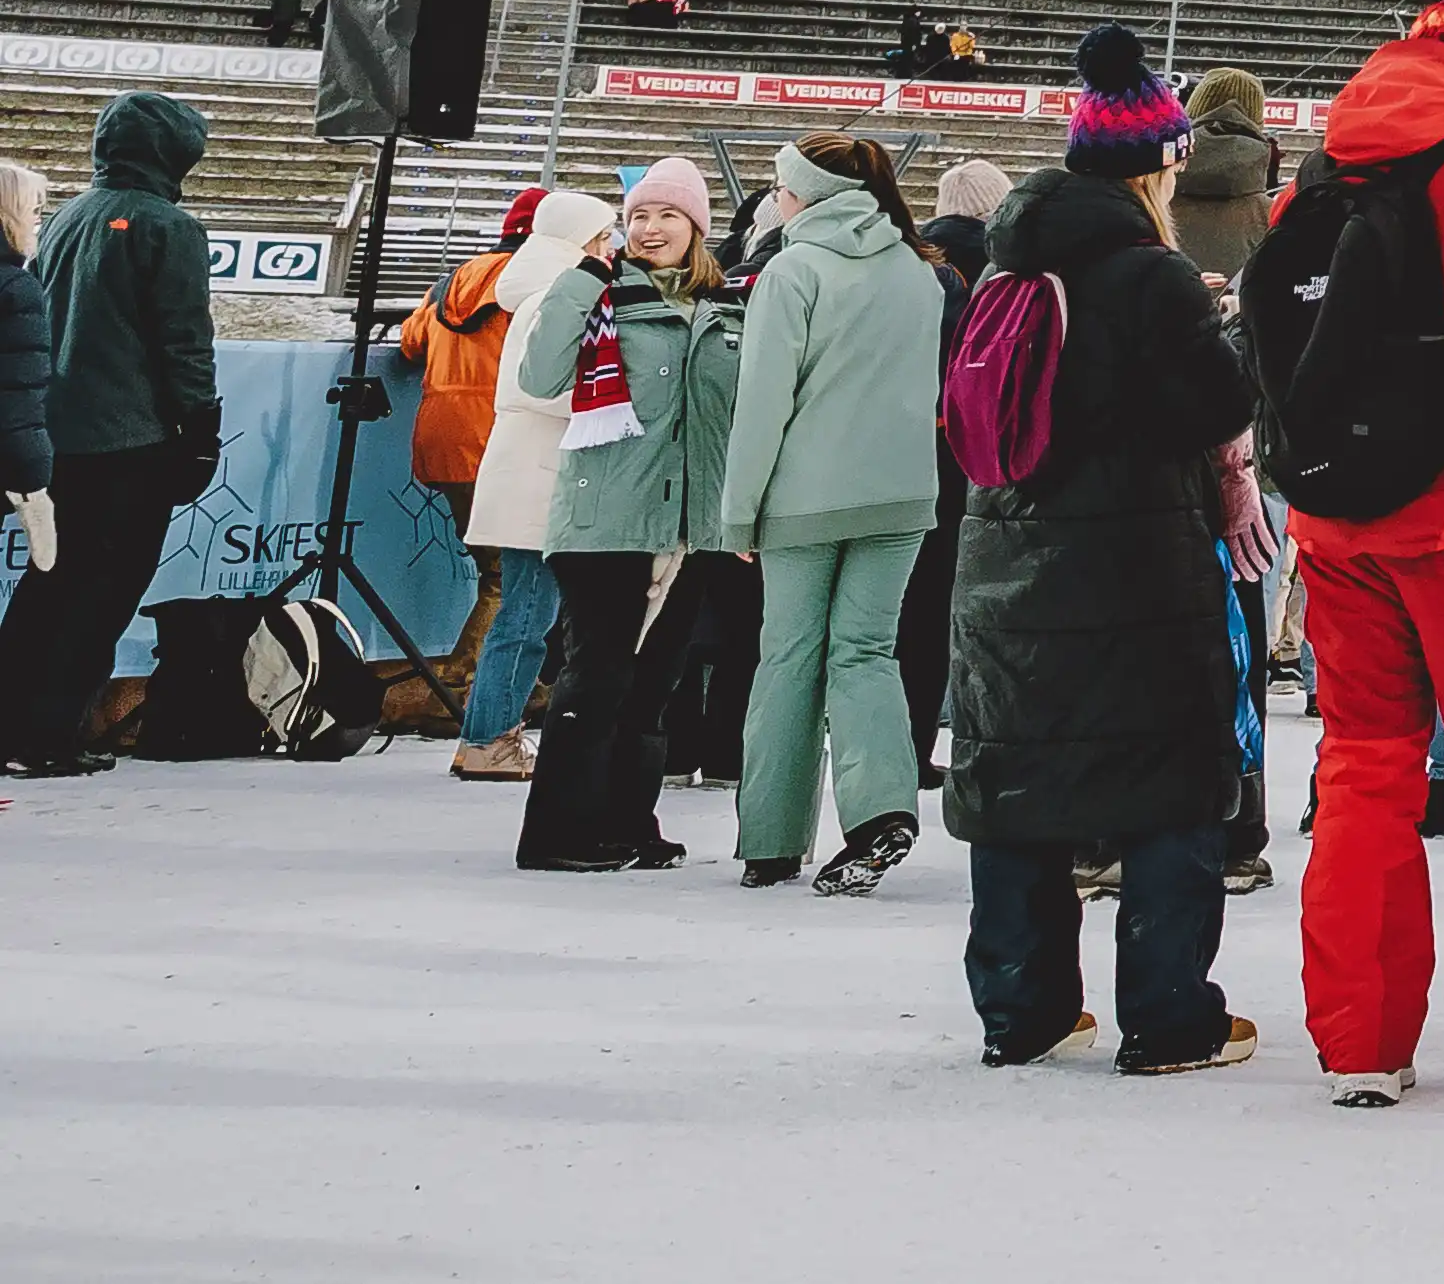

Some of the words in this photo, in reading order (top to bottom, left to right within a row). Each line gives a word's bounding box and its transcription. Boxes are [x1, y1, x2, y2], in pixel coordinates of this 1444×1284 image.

[637, 75, 736, 94] VEIDEKKE
[785, 83, 881, 101] VEIDEKKE
[929, 90, 1024, 109] VEIDEKKE
[207, 242, 236, 274] D
[259, 244, 317, 277] GD
